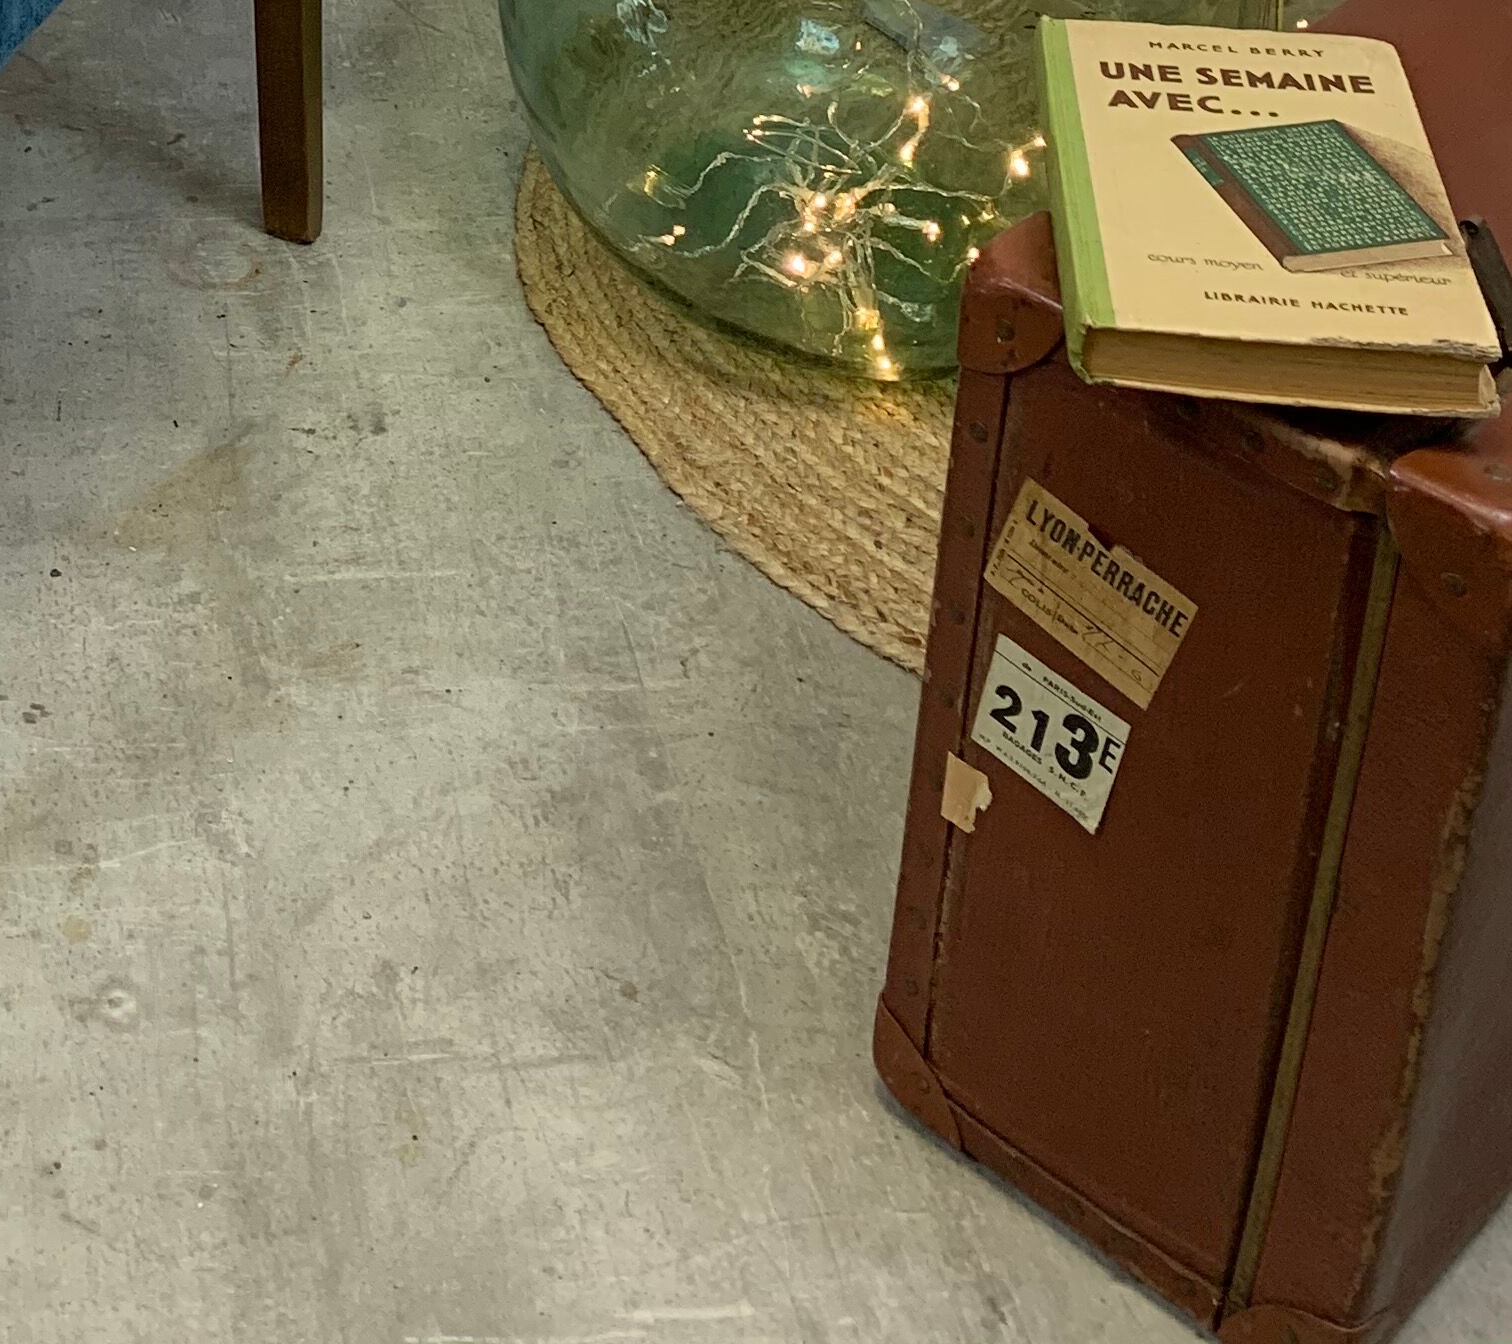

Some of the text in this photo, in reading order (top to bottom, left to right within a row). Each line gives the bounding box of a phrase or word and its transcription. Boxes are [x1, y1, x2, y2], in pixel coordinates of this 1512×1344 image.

[1149, 41, 1324, 58] MARCEL BERRY
[1099, 60, 1376, 95] UNE SEMAINE
[1108, 89, 1279, 118] AVEC...
[1204, 257, 1264, 272] moyen
[1203, 291, 1409, 317] LIBRAIRIE HACHETTE
[1002, 731, 1043, 765] BAGAGES
